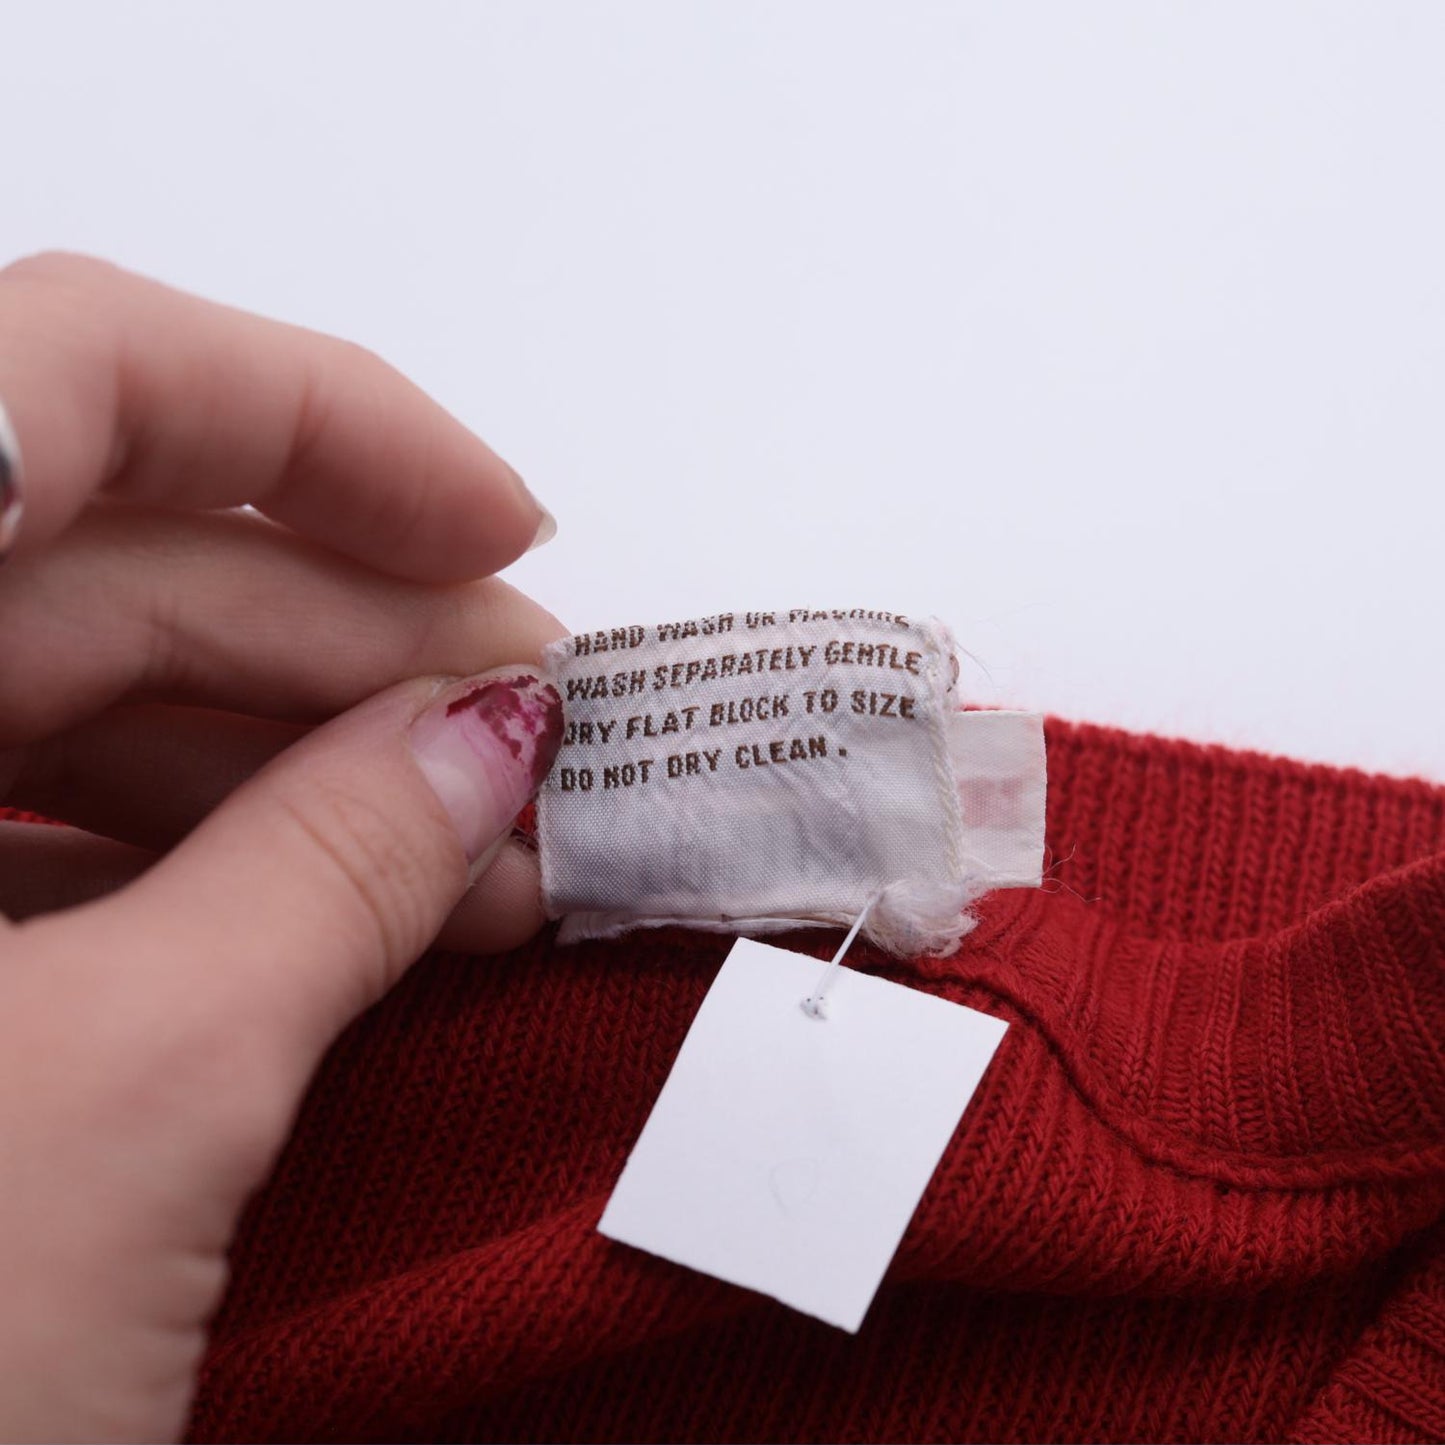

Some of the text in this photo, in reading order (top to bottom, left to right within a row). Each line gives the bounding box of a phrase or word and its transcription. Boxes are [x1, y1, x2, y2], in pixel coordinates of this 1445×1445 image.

[575, 625, 645, 656] HAND
[657, 612, 734, 641] WASH
[567, 640, 923, 701] WASH SEPARATELY GENTLE
[626, 706, 701, 740] FLAT
[709, 694, 790, 727] BLOCK
[803, 688, 839, 714] TO
[850, 689, 916, 720] SIZE
[561, 767, 594, 791] DO
[603, 759, 655, 790] NOT
[667, 748, 723, 779] DRY
